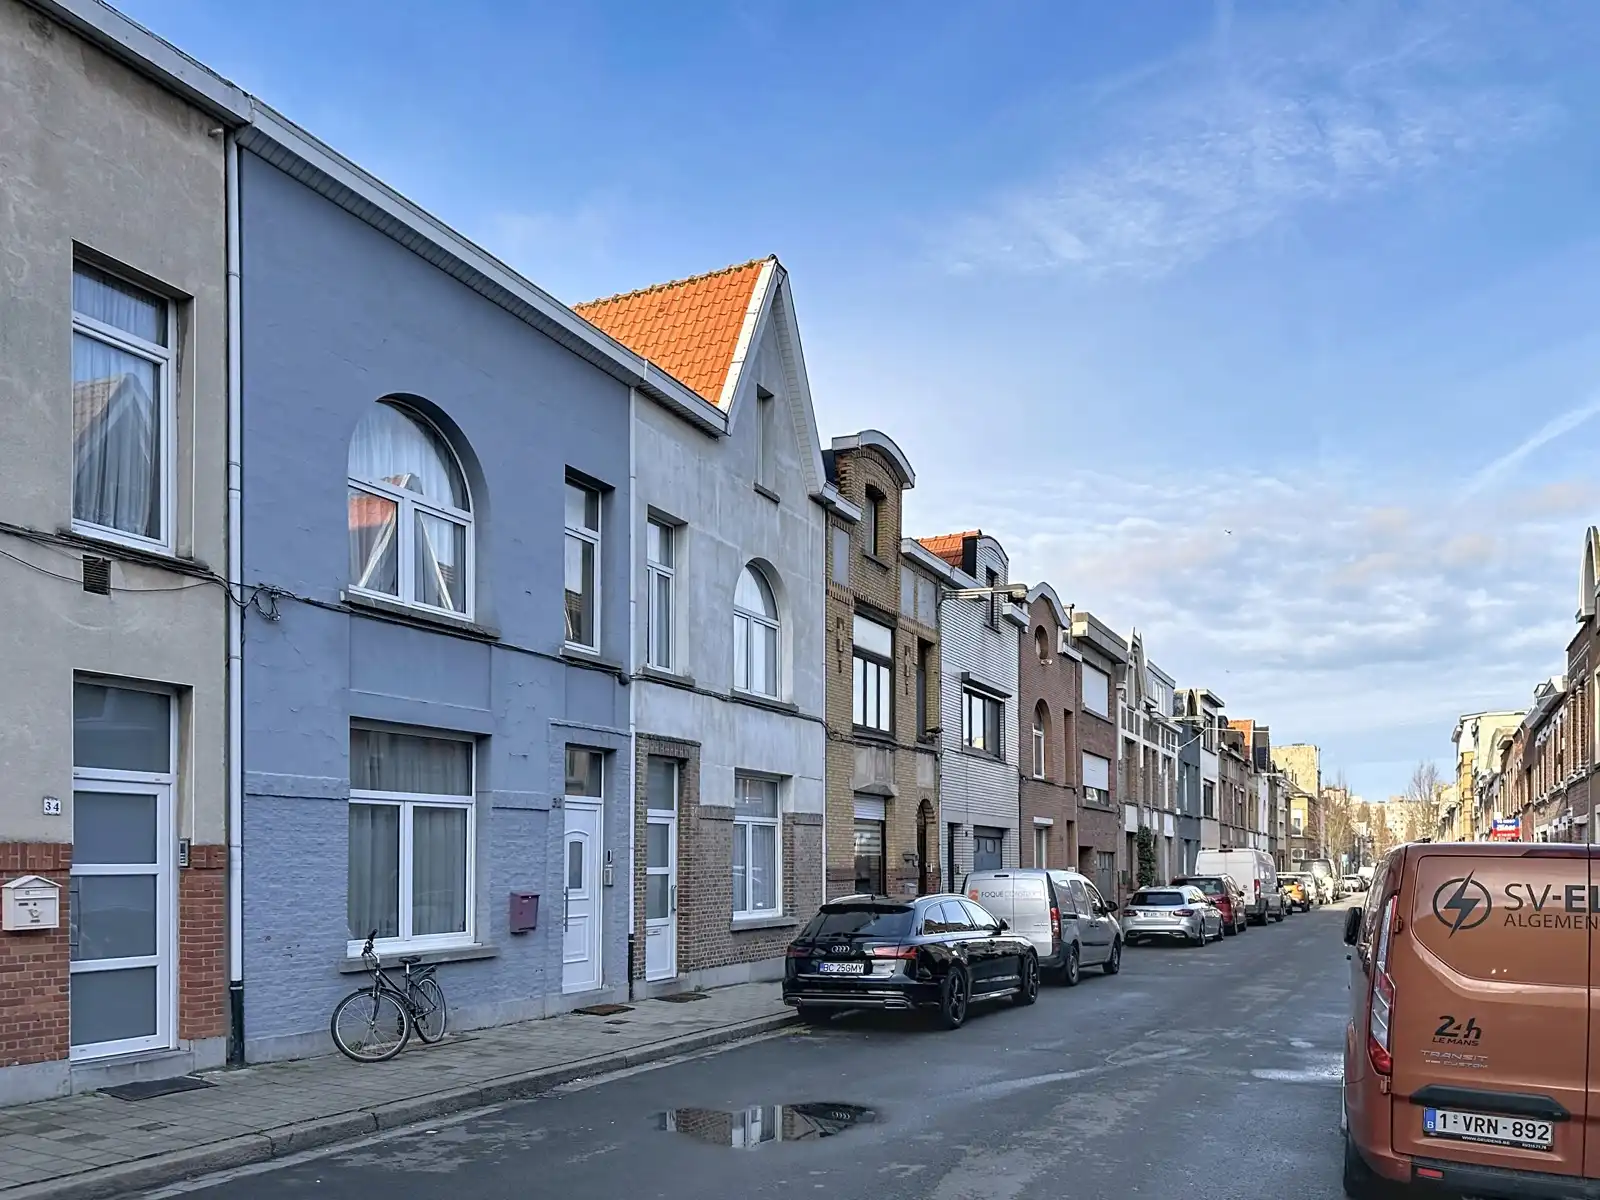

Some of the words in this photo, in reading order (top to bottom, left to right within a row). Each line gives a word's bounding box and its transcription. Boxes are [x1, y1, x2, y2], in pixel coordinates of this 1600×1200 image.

[46, 801, 59, 811] 34
[1503, 883, 1600, 913] SV-EL
[1445, 1038, 1479, 1047] MANS
[1420, 1049, 1489, 1062] TRANSIT
[1443, 1060, 1488, 1069] CUSTOM
[1427, 1120, 1434, 1129] B
